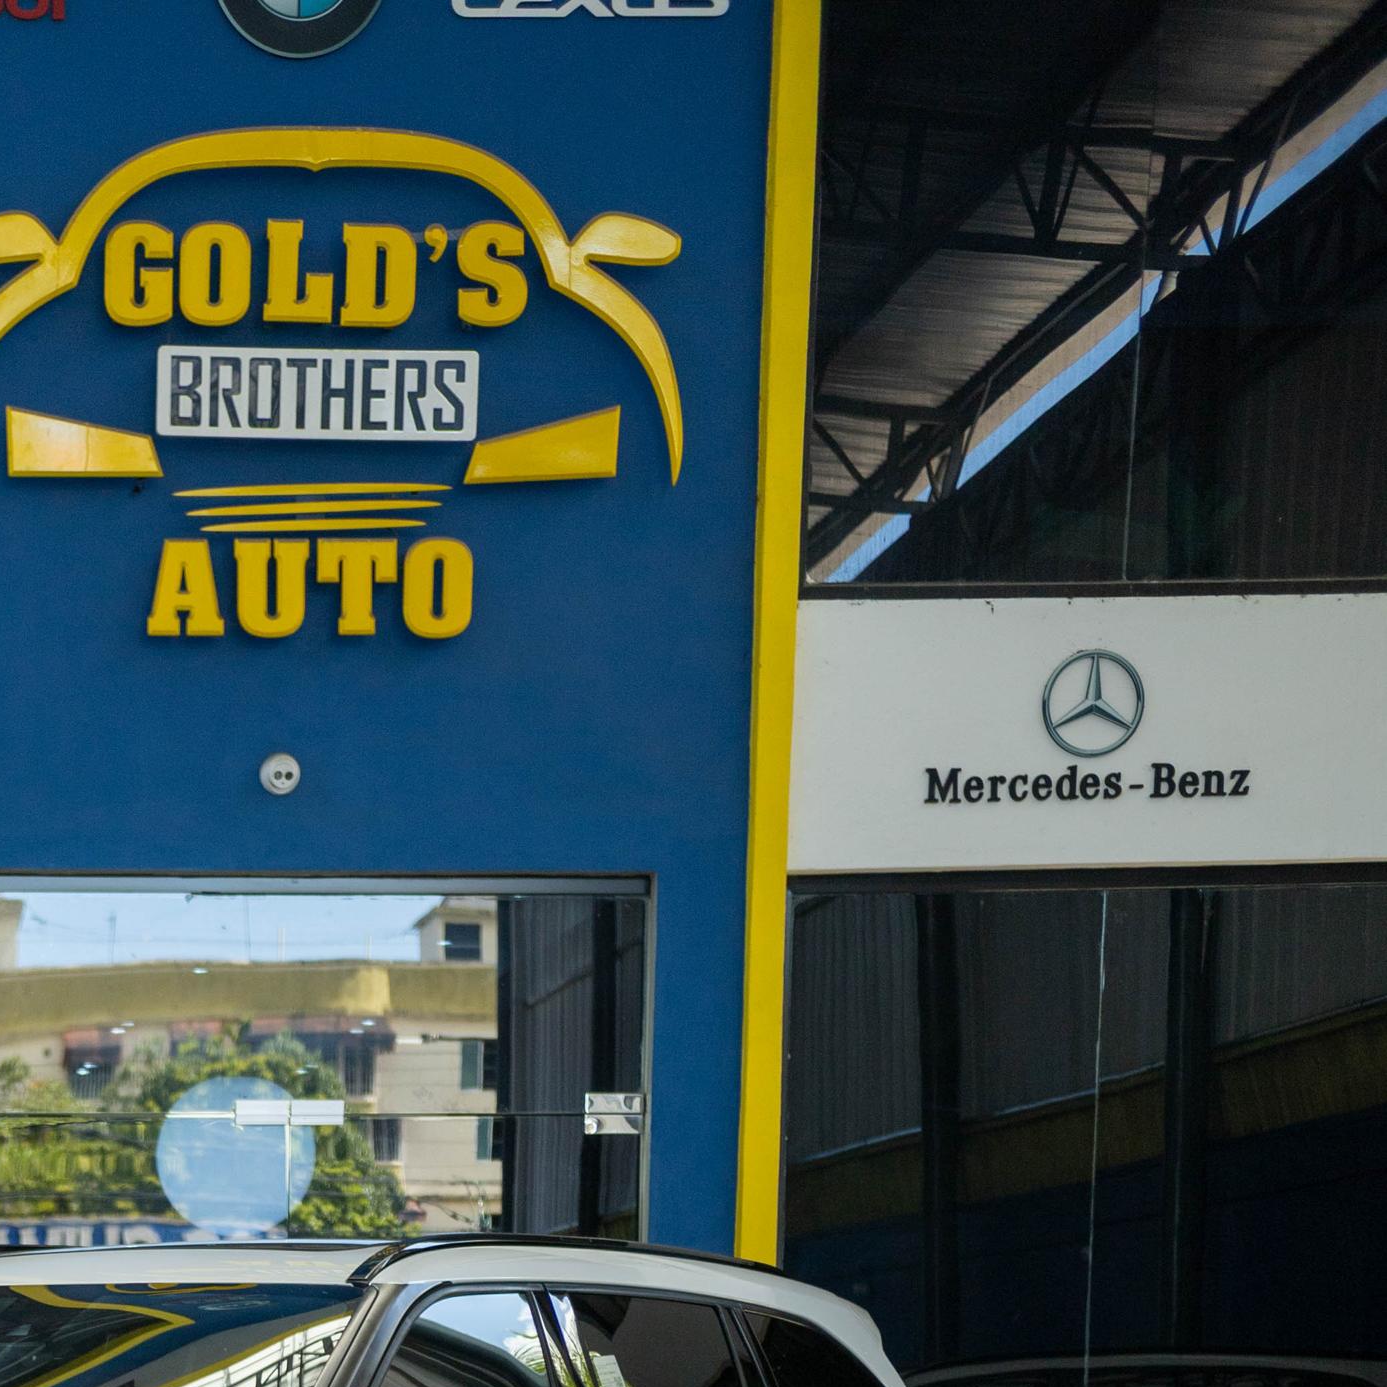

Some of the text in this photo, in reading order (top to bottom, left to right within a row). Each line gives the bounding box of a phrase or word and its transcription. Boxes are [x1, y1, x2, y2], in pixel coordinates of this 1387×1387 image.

[104, 219, 528, 328] GOLD'S
[170, 355, 467, 432] BROTHERS
[147, 537, 474, 640] AUTO
[924, 763, 1251, 805] Mercedes-Benz
